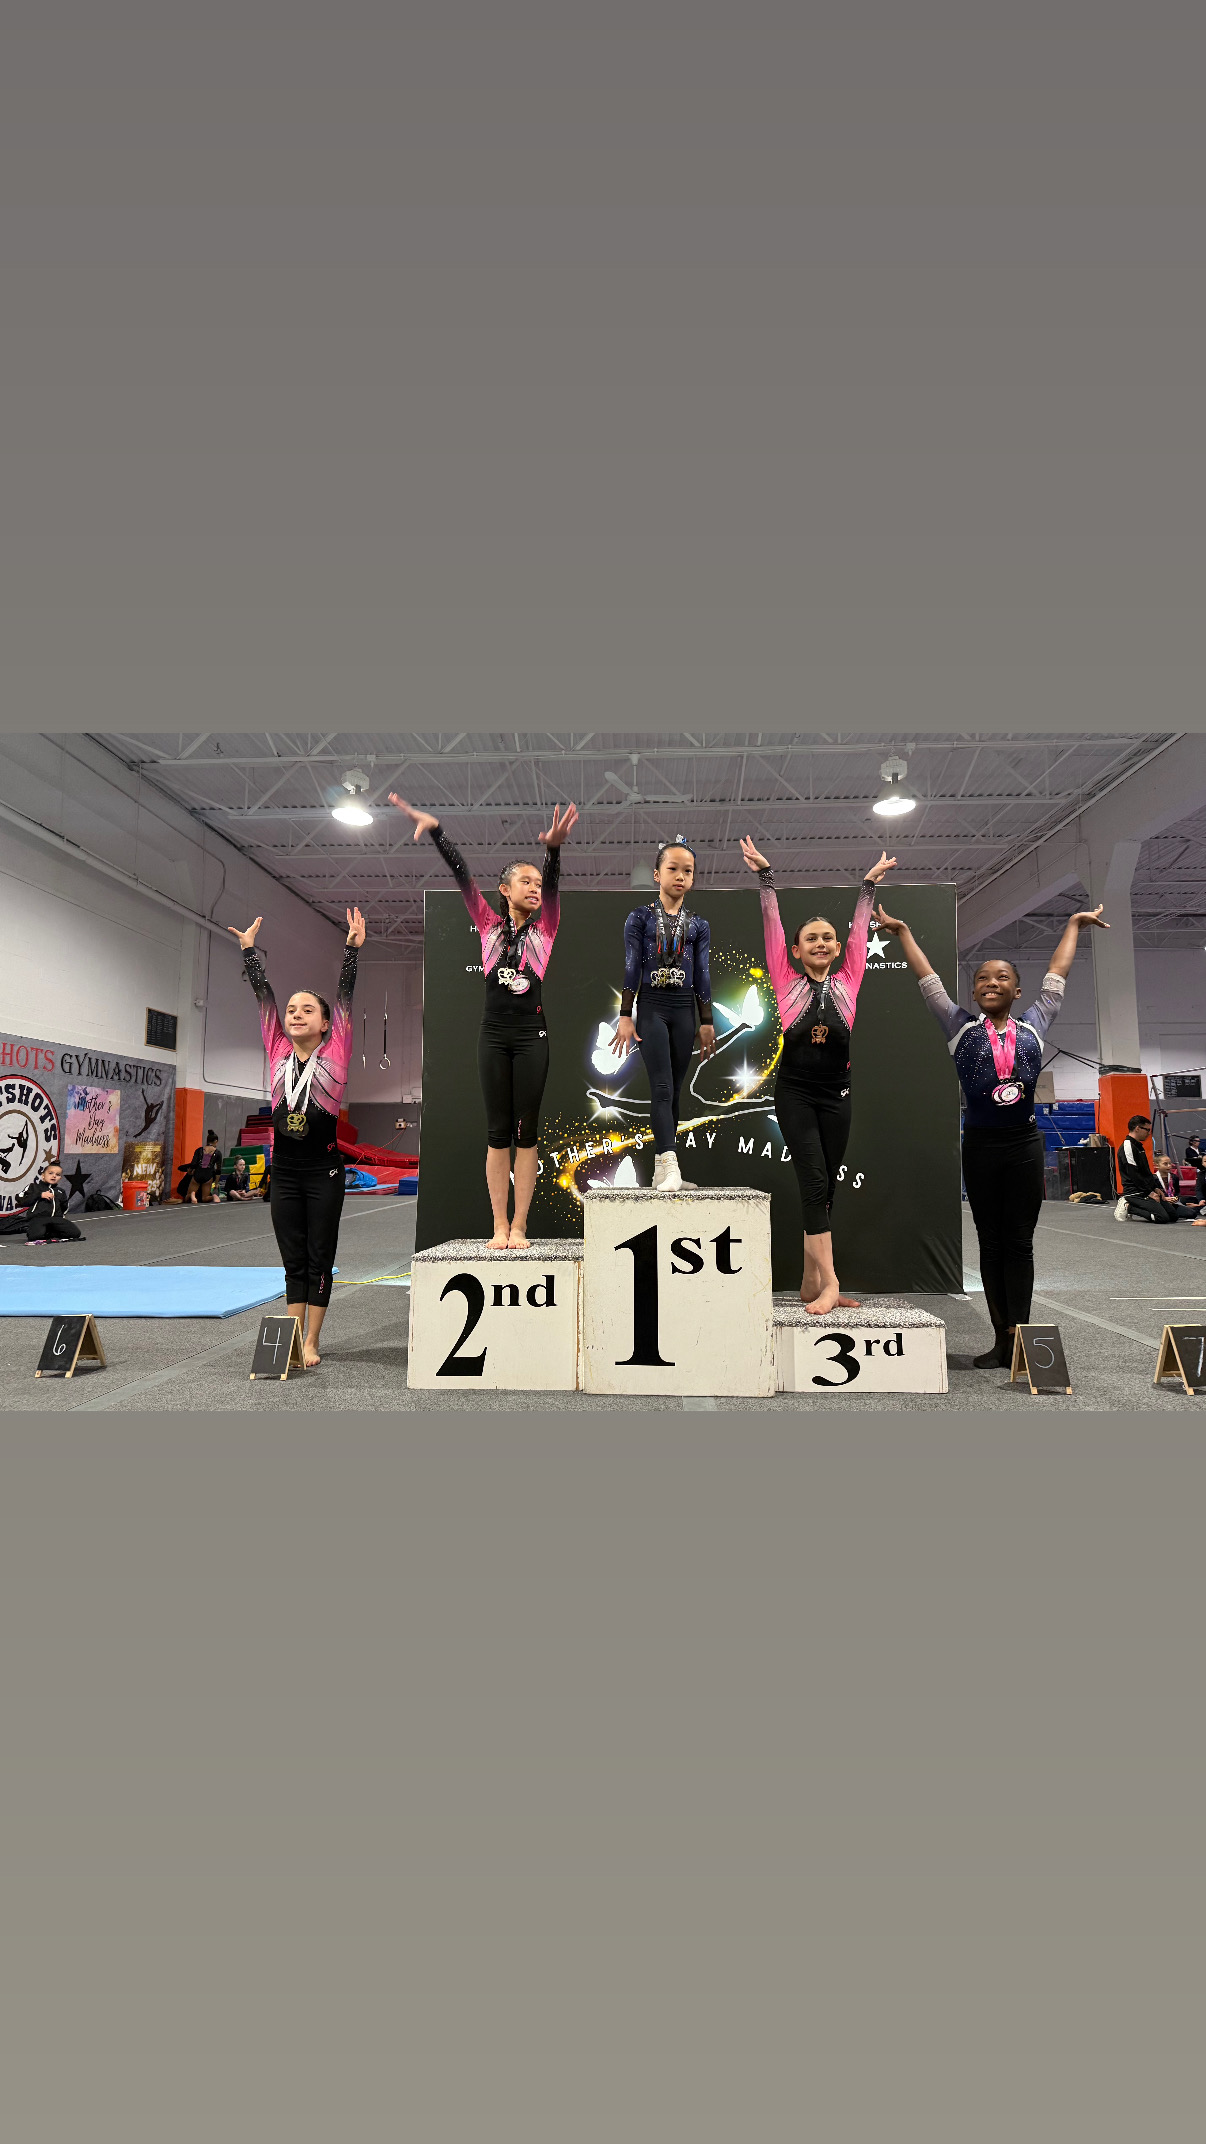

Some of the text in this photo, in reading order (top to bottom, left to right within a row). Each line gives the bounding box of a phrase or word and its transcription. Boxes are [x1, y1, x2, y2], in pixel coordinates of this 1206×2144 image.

[866, 962, 908, 970] NASTICS
[0, 1042, 162, 1087] HOTS GYMNASTICS
[0, 1083, 58, 1143] SHOTS
[75, 1127, 110, 1149] Madness
[133, 1163, 157, 1176] NEW
[675, 1131, 716, 1149] AY
[737, 1136, 865, 1189] MADSS
[614, 1224, 742, 1367] 1st
[52, 1323, 67, 1356] 6
[261, 1326, 283, 1365] 4
[435, 1272, 557, 1377] 2nd
[811, 1332, 906, 1387] 3rd
[1033, 1336, 1056, 1369] 5
[1181, 1336, 1206, 1378] 7
